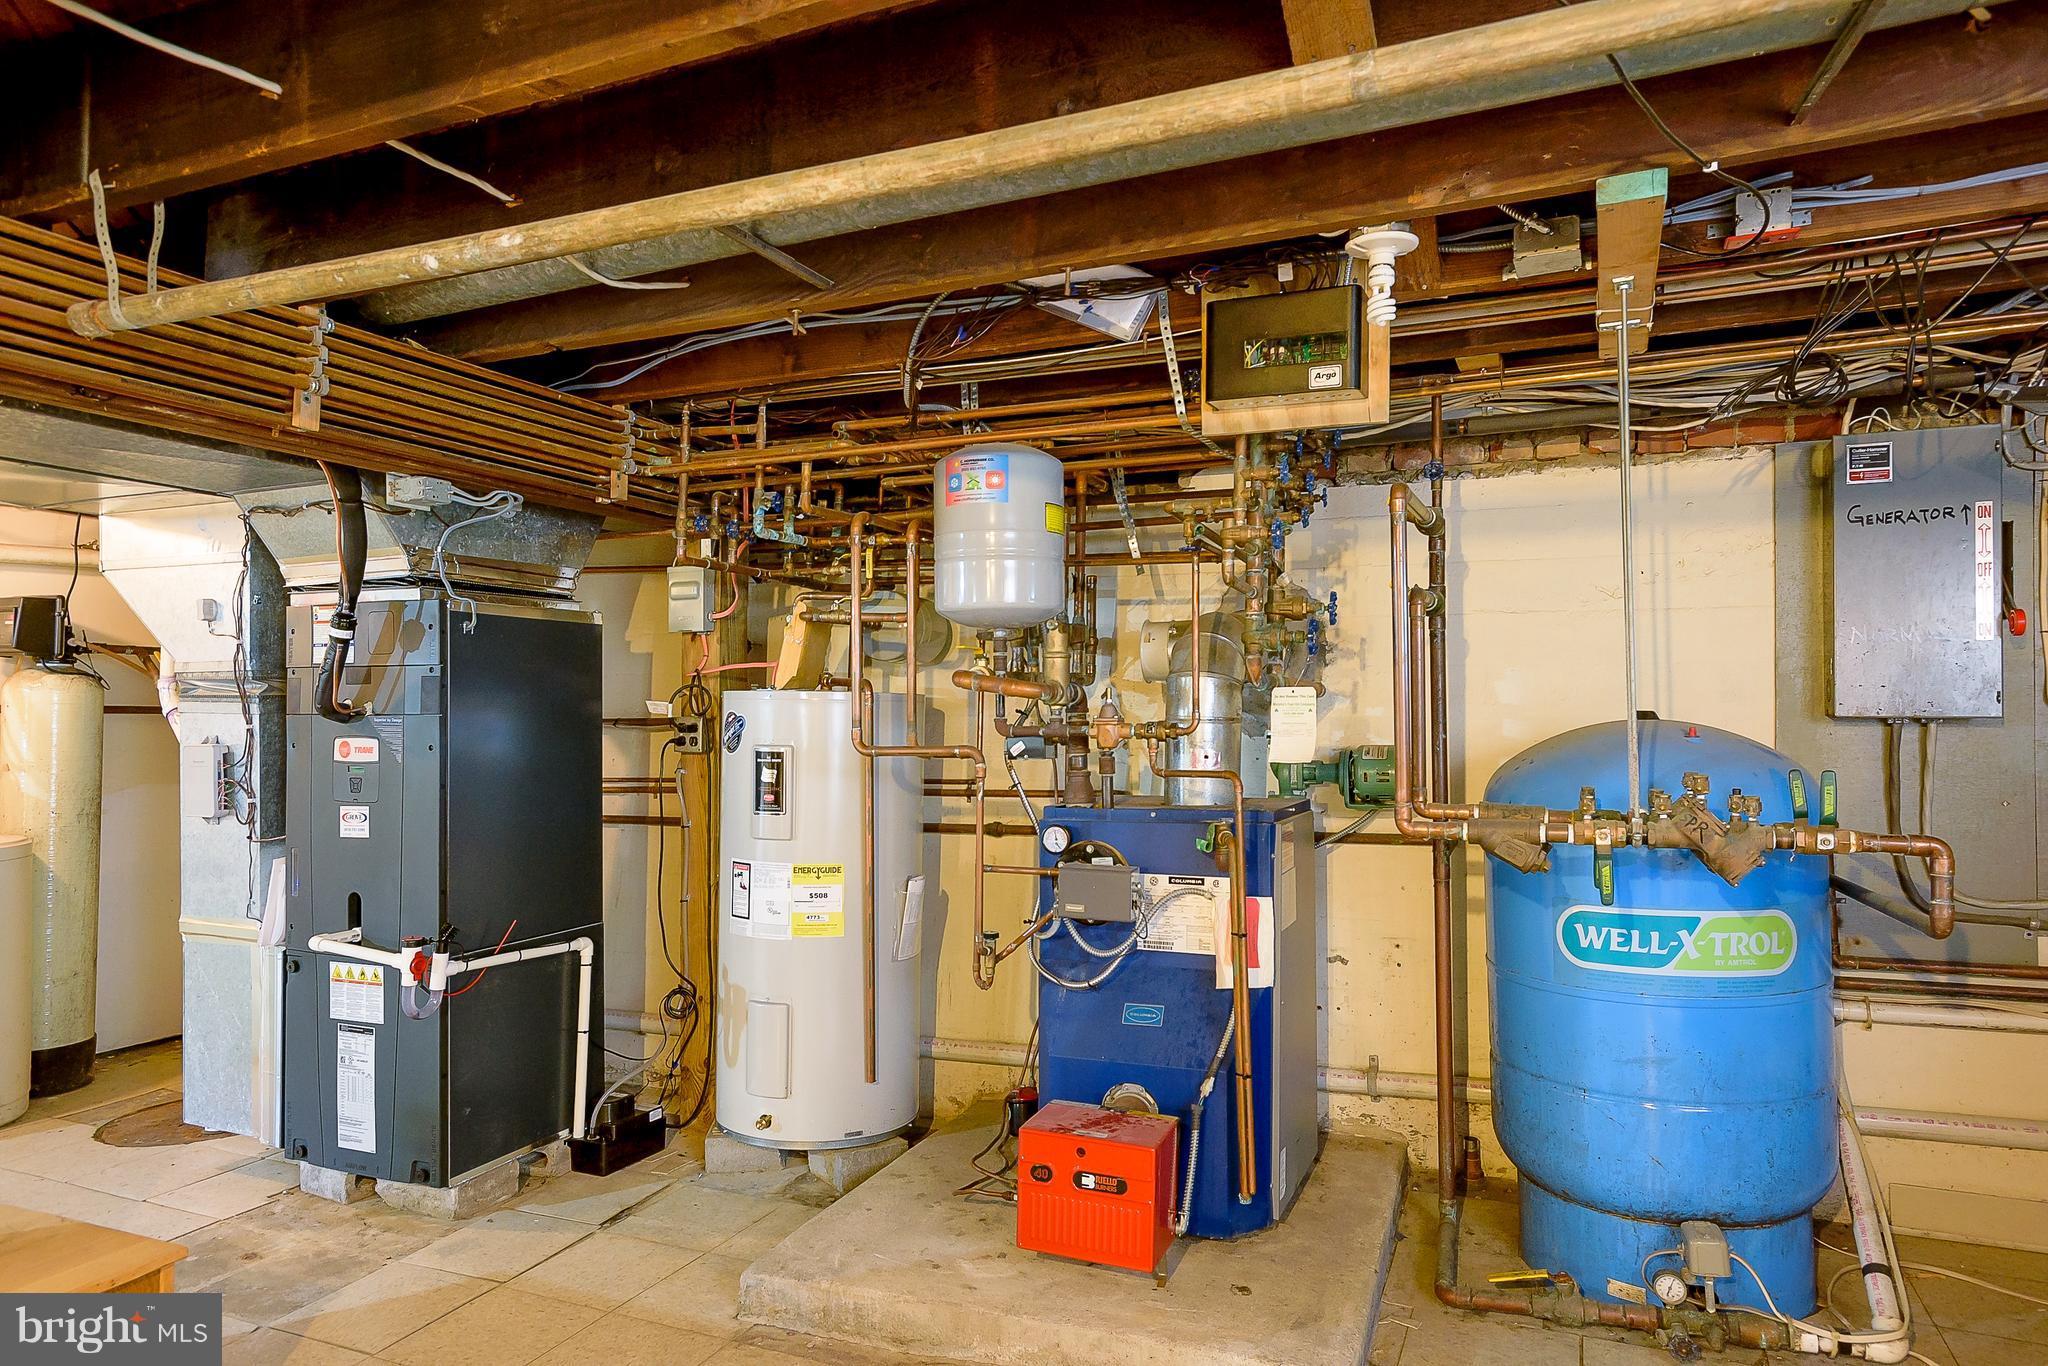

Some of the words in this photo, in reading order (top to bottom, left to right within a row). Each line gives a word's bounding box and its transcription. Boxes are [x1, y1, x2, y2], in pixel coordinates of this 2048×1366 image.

[1314, 372, 1337, 381] Argo
[1847, 504, 1955, 527] GENERATOR
[1977, 505, 1992, 519] ON
[1977, 562, 1992, 577] OFF
[354, 746, 374, 754] TRANE
[793, 866, 842, 876] ENERGYGUIDE
[1034, 1168, 1048, 1179] 40
[1095, 1175, 1118, 1186] RIELLO
